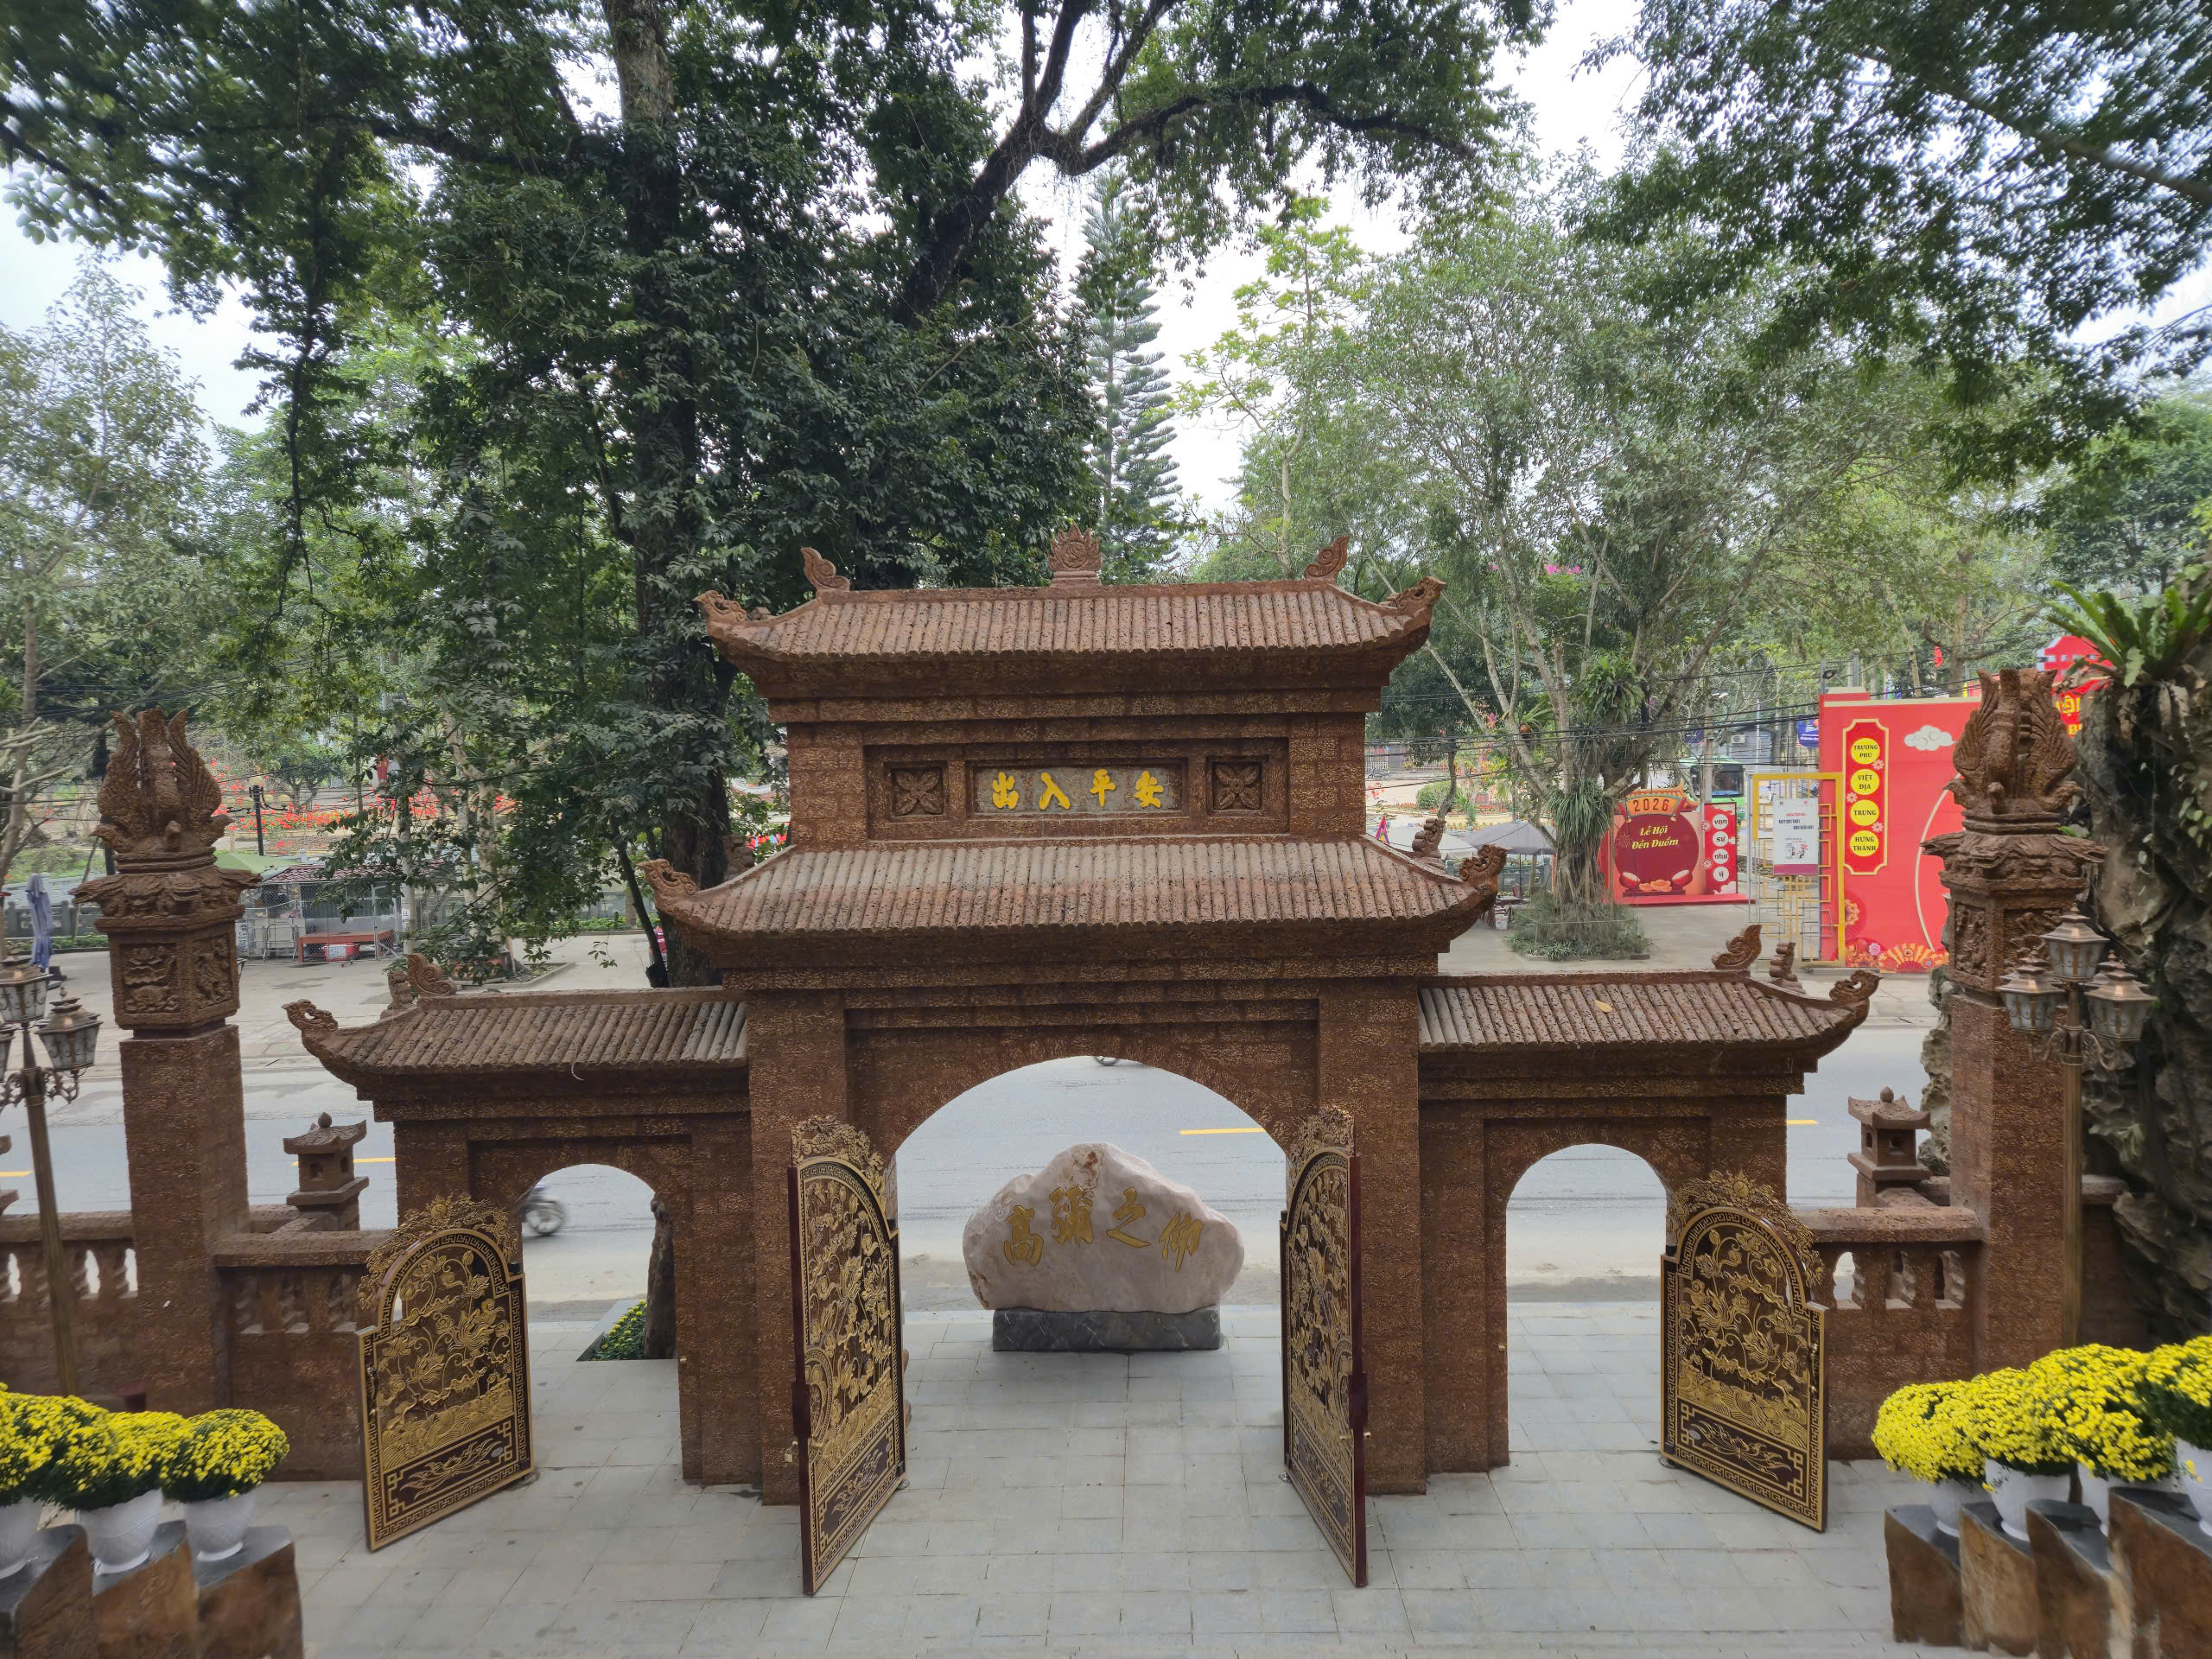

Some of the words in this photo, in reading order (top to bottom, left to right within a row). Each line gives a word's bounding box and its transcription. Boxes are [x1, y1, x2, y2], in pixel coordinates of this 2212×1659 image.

[992, 769, 1164, 810] 出入平安
[1633, 798, 1669, 812] 2026
[1640, 825, 1651, 836] Lễ
[1653, 825, 1669, 836] Hội
